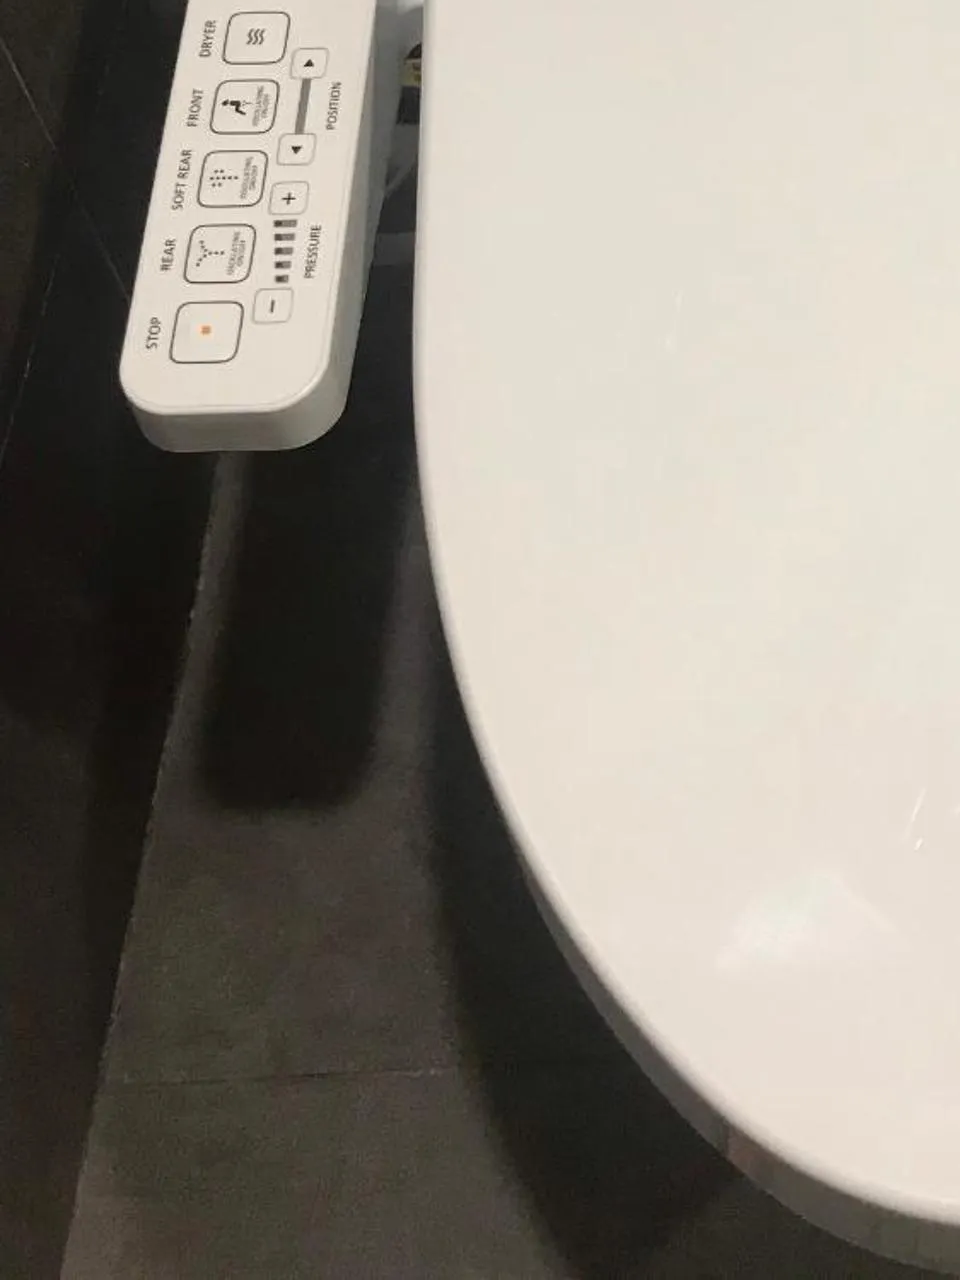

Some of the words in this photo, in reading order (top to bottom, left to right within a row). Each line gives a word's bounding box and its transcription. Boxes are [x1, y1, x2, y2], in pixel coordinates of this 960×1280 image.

[199, 20, 217, 58] DRYER
[187, 88, 204, 127] FRONT
[325, 81, 342, 131] POSITION
[177, 149, 192, 179] REAR
[172, 182, 187, 211] SOFT
[160, 238, 176, 272] REAR
[304, 224, 322, 279] PRESSURE
[146, 317, 162, 350] STOP
